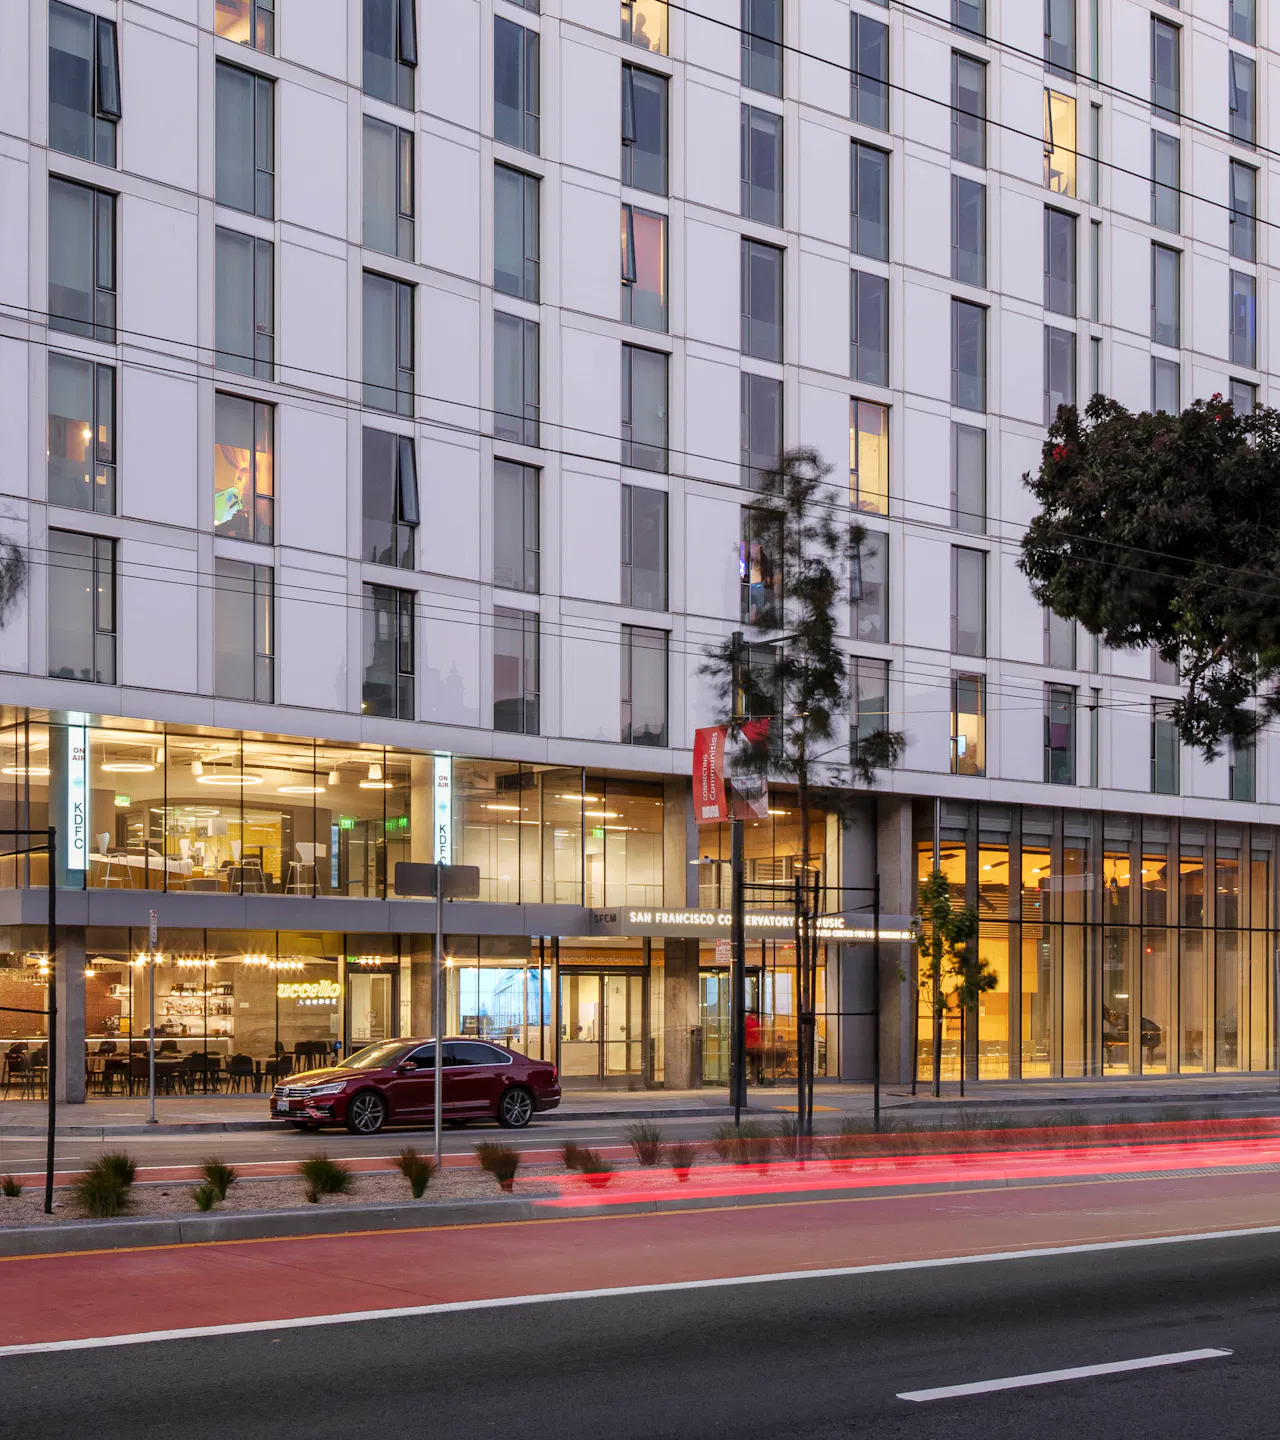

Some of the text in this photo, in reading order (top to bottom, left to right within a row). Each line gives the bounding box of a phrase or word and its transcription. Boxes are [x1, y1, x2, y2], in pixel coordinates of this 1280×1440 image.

[709, 732, 718, 801] Communities
[74, 802, 84, 850] KDFC
[594, 913, 617, 924] SFCM
[630, 911, 651, 923] SAN
[655, 912, 714, 925] FRANCISCO
[717, 914, 795, 927] COERVATORY
[277, 979, 342, 998] uccello
[299, 998, 337, 1006] LOUNGE
